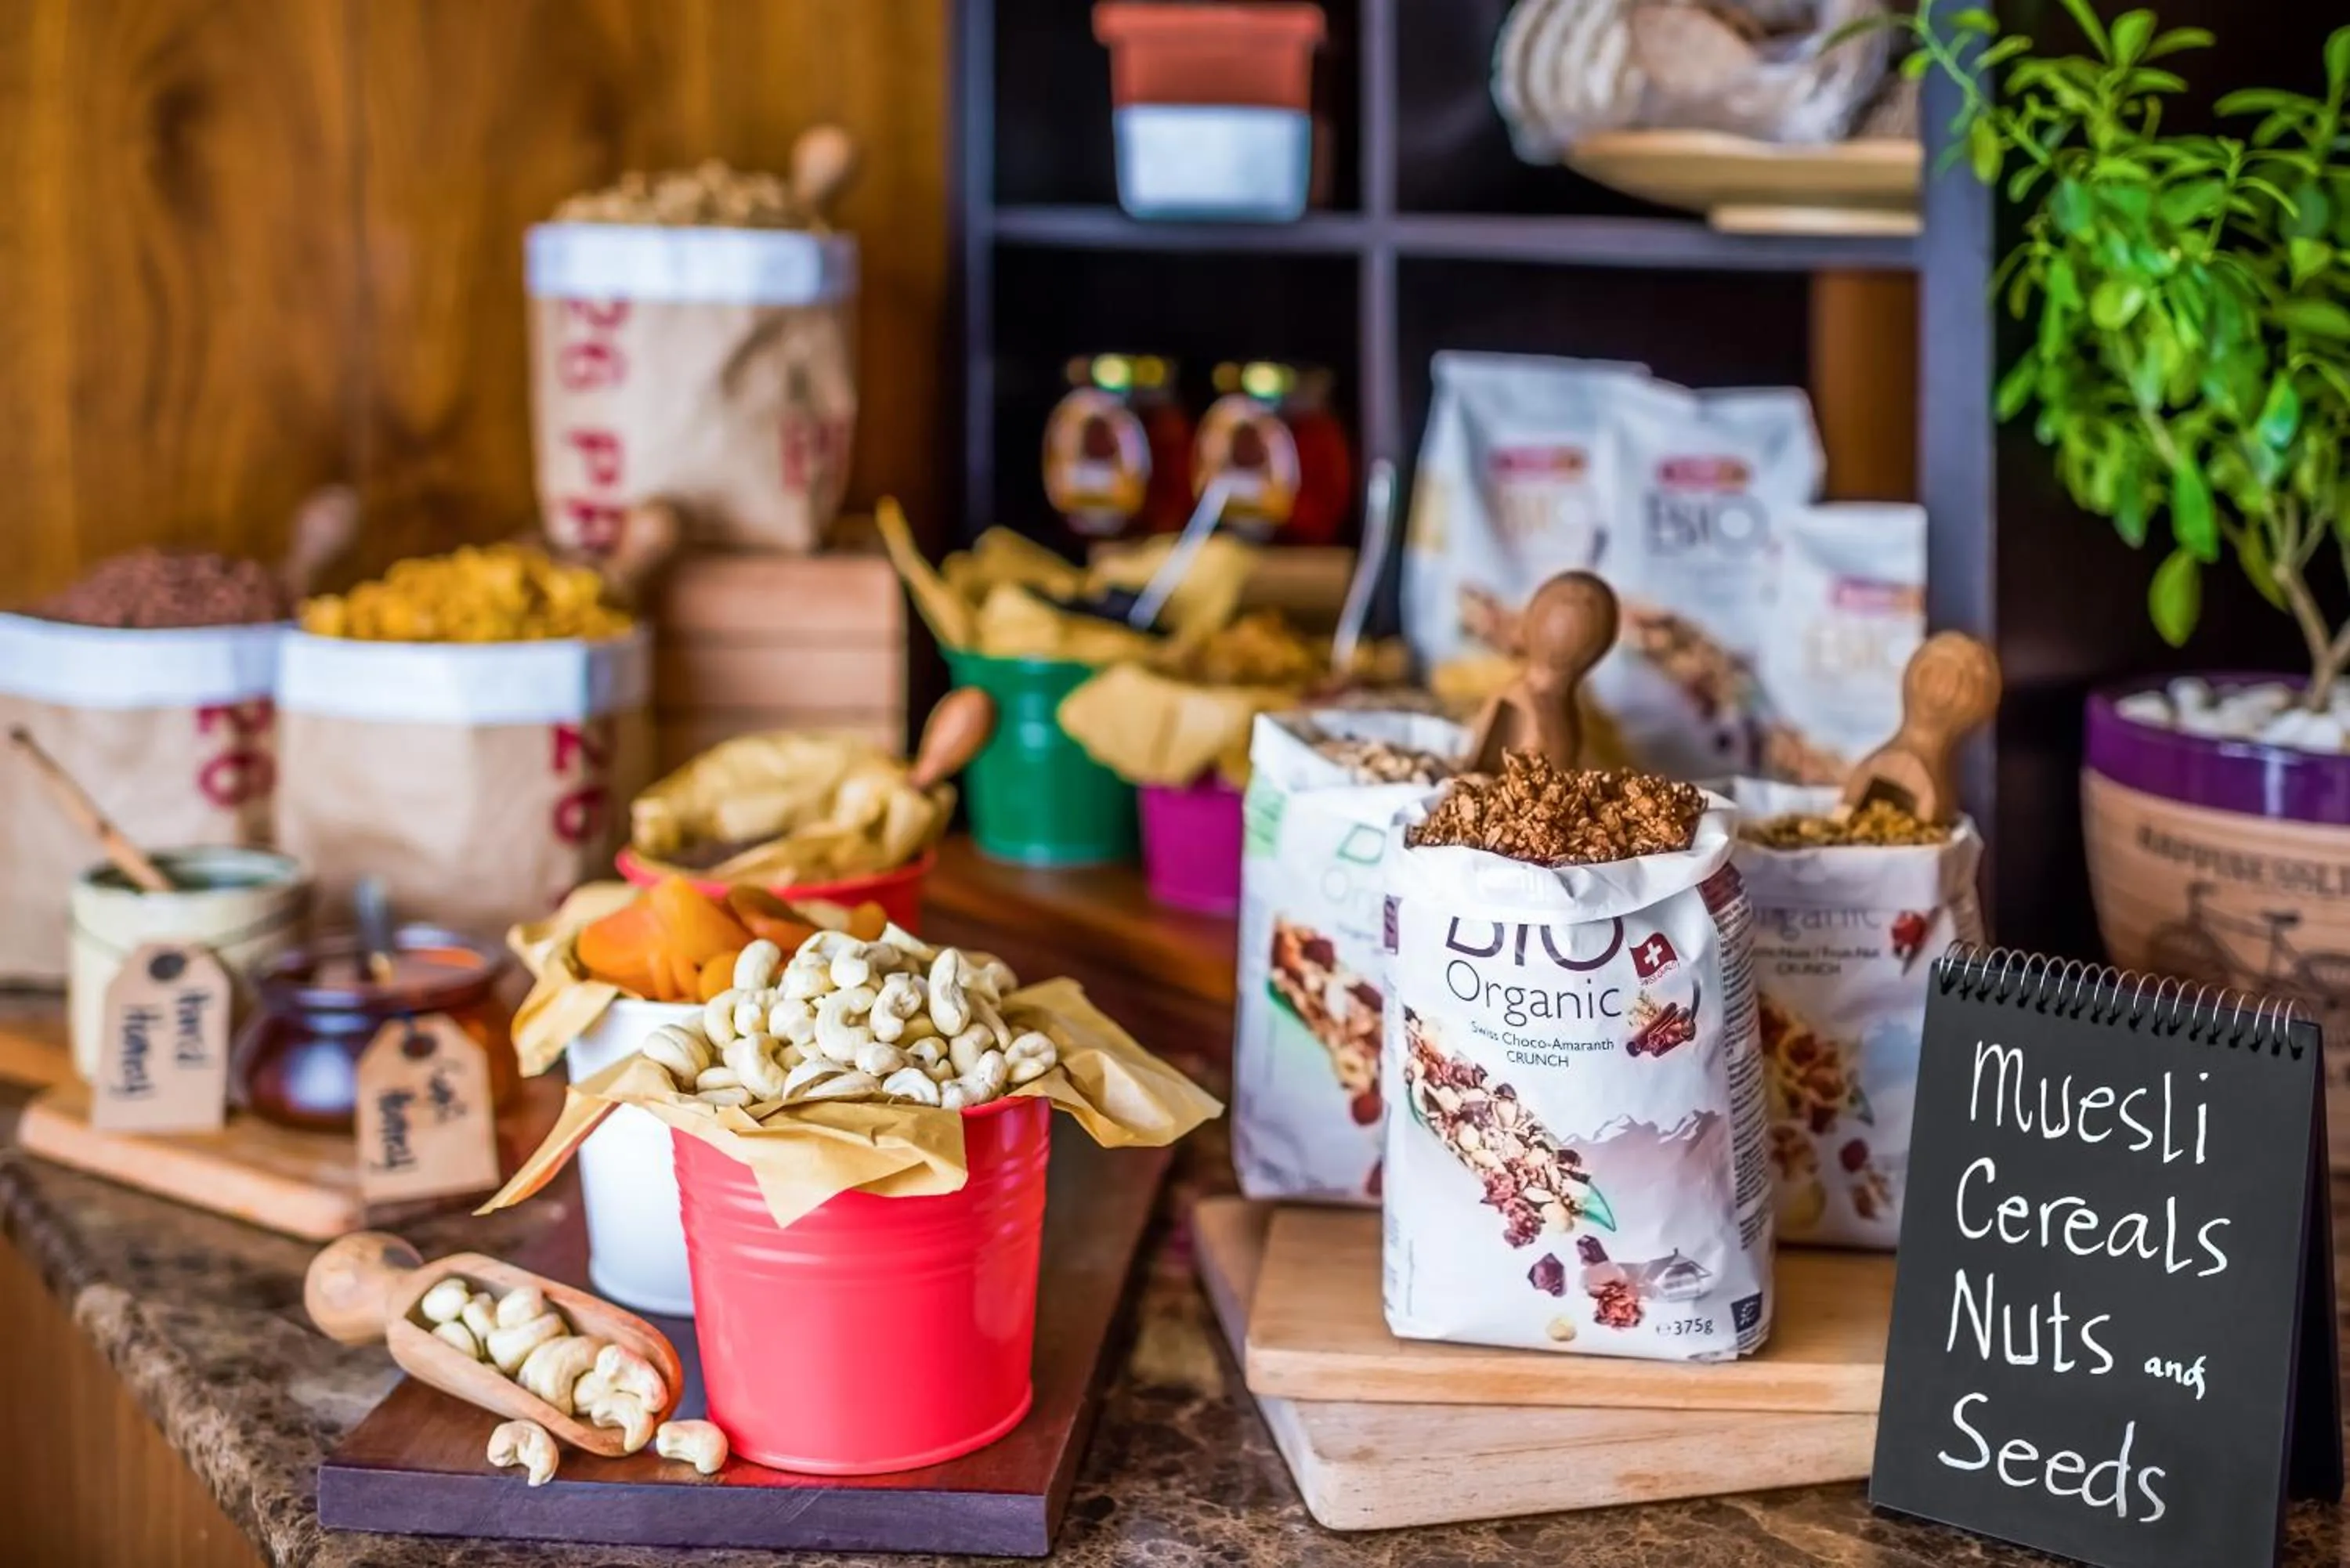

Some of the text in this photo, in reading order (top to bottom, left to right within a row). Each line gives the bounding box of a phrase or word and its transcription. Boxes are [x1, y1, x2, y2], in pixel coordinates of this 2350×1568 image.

[1447, 959, 1622, 1027] Organic
[1471, 1021, 1614, 1051] Swiss Choco-Amaranth
[1506, 1050, 1569, 1067] CRUNCH
[1955, 1157, 2232, 1277] Cereals
[1946, 1268, 2207, 1400] Nuts and
[1937, 1392, 2167, 1524] Seeds
